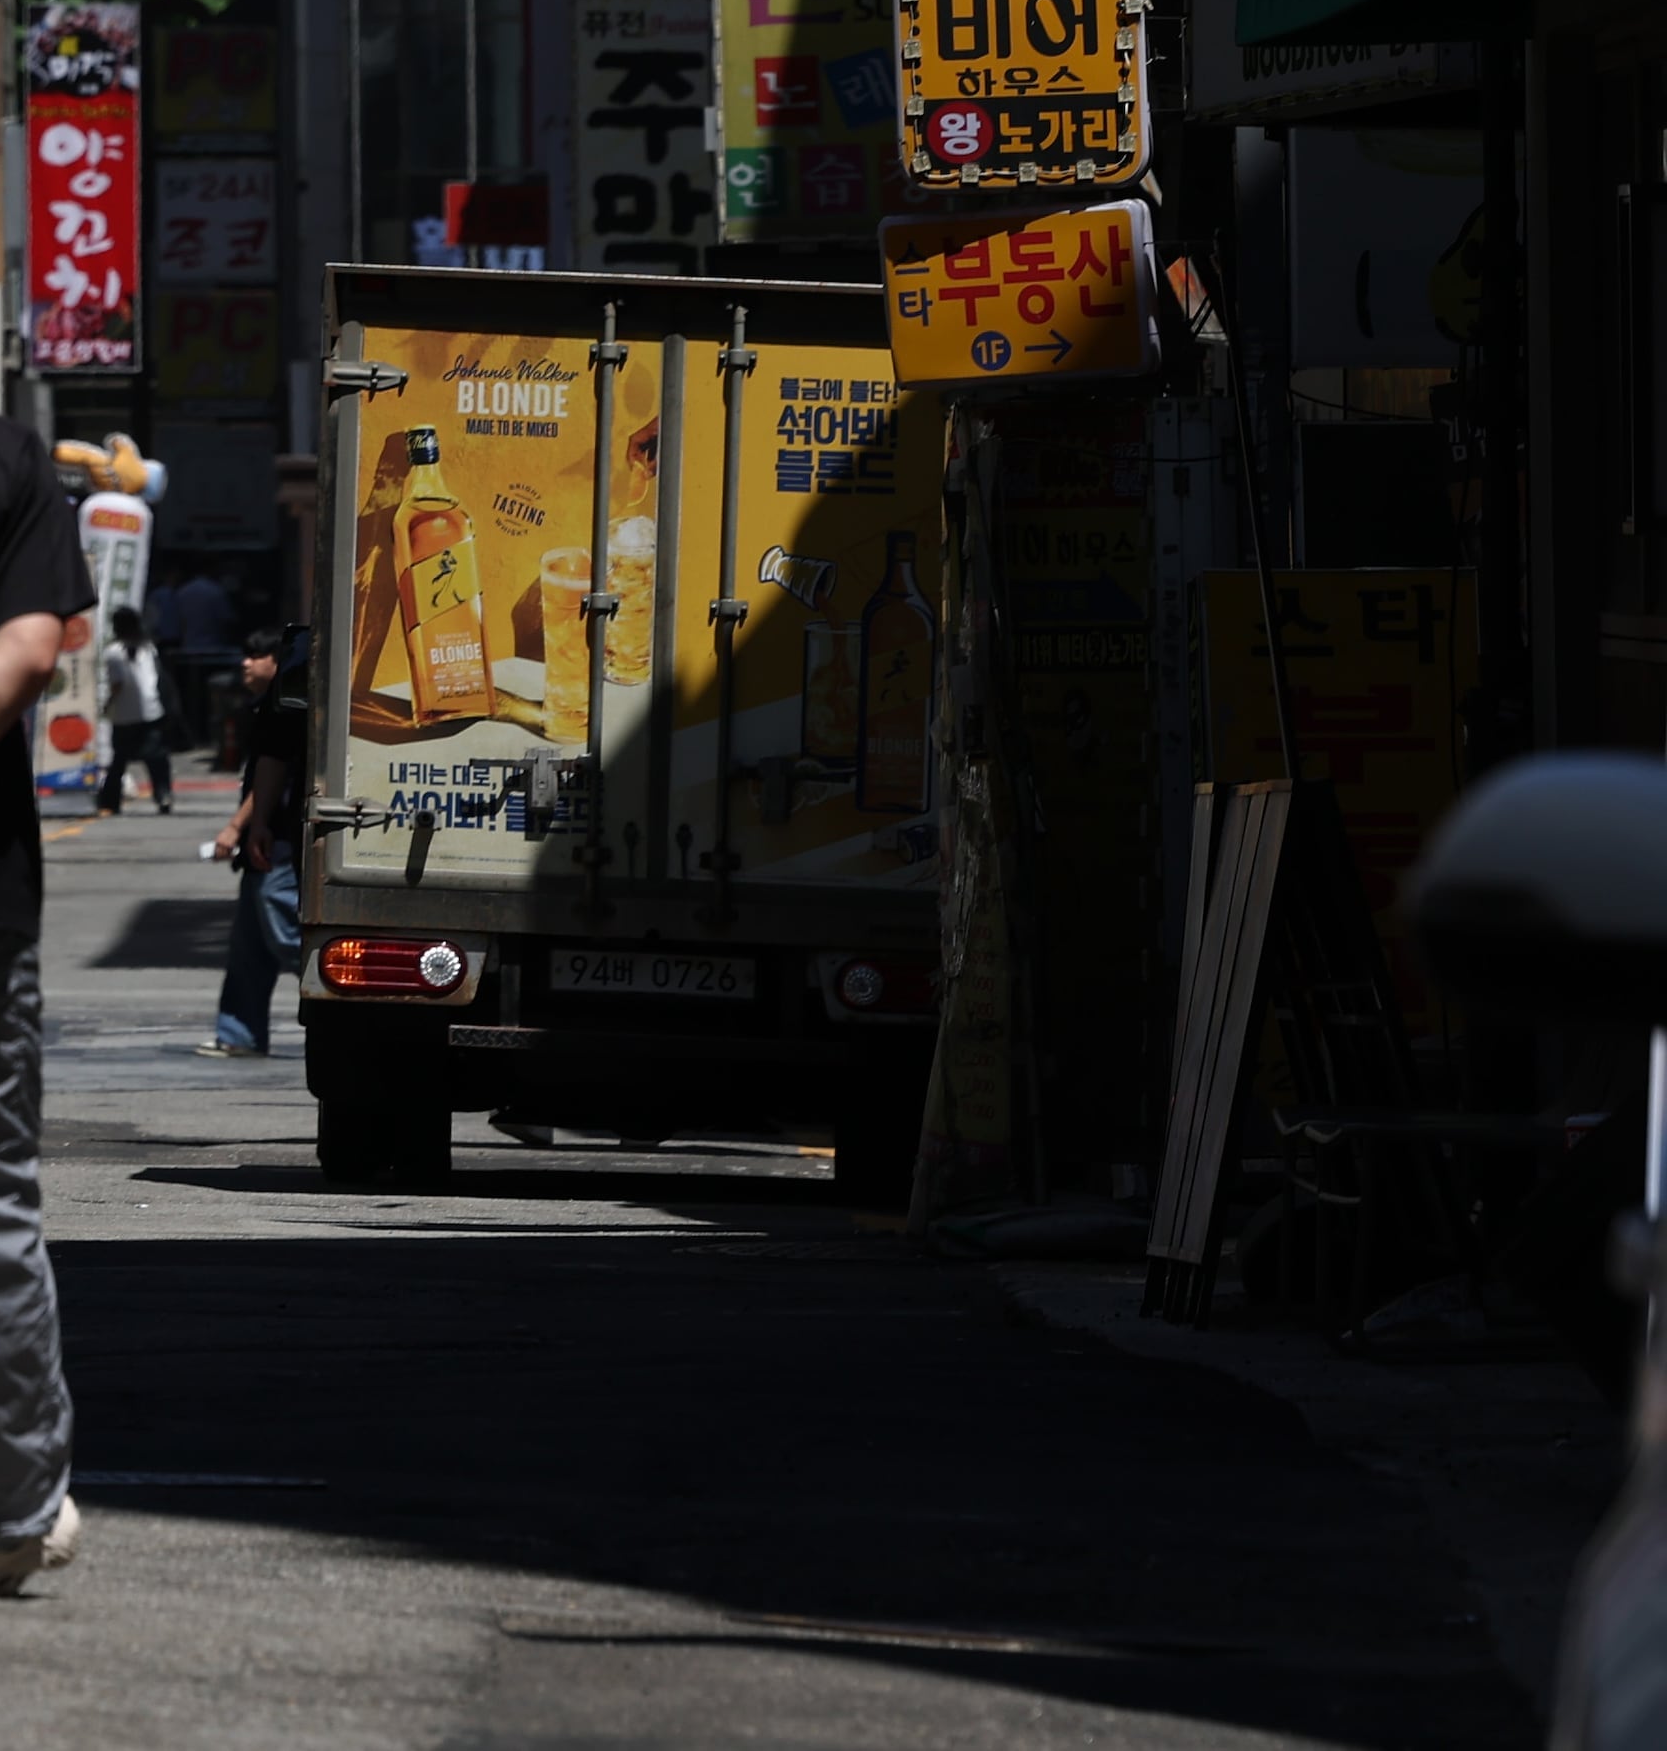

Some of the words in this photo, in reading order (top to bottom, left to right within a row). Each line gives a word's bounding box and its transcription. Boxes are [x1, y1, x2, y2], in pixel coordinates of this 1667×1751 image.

[582, 11, 647, 38] 퓨전
[760, 53, 895, 122] 노래
[956, 67, 1085, 96] 하우스
[939, 112, 982, 156] 왕
[998, 108, 1119, 154] 노가리
[894, 242, 933, 326] 스타
[939, 225, 1130, 327] 부동산
[443, 354, 514, 382] Johnnie
[517, 357, 579, 382] Walker
[977, 336, 1005, 366] 1F
[457, 380, 569, 418] BLONDE
[780, 378, 841, 401] 불금에
[849, 380, 899, 404] 불타!
[465, 418, 496, 436] MADE
[497, 419, 510, 436] TO
[511, 420, 525, 437] BE
[526, 421, 559, 438] MIXED
[776, 405, 899, 447] 섞어봐!
[775, 450, 897, 494] 블론드
[492, 493, 546, 527] TASTING
[430, 642, 483, 665] BLONDE
[389, 762, 447, 786] 내키는
[452, 763, 498, 791] 대로,
[652, 958, 737, 993] 0726
